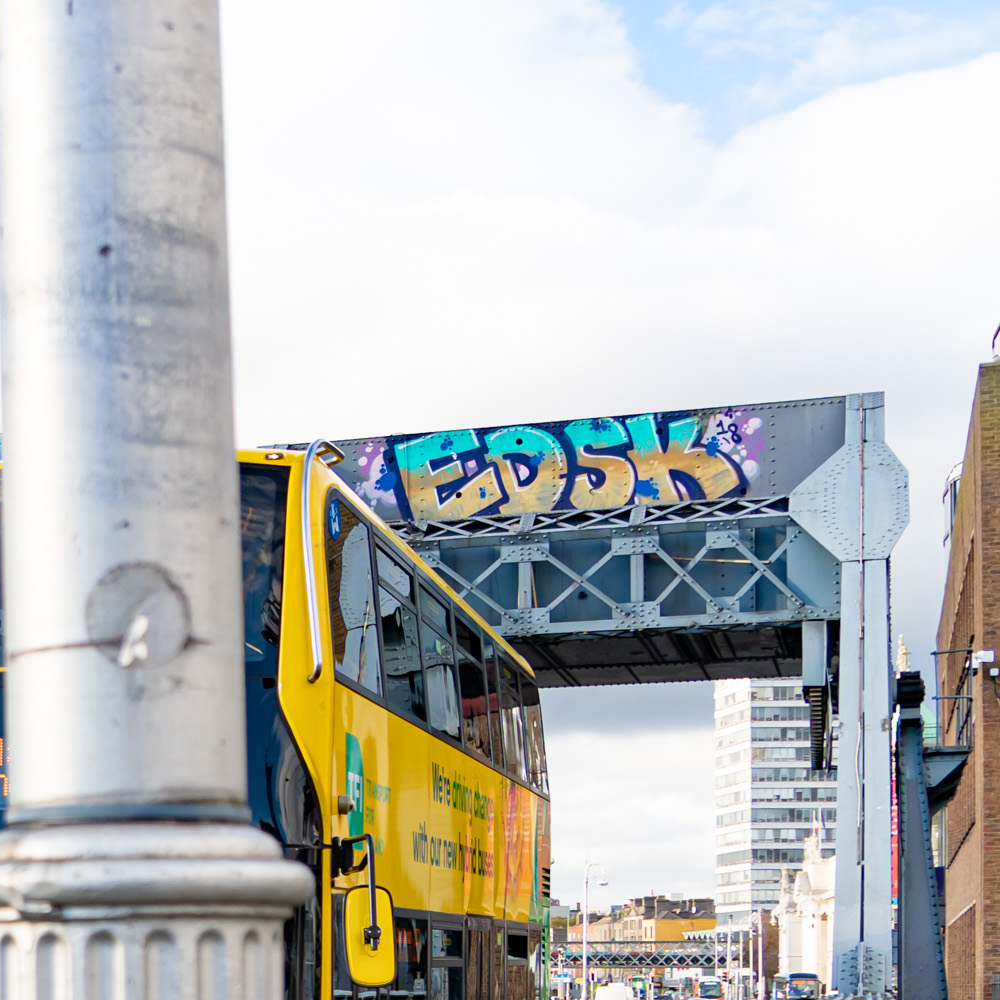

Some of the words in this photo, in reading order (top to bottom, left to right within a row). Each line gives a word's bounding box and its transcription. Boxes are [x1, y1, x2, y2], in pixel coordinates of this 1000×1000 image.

[392, 412, 746, 522] EDSK
[347, 771, 363, 813] TFI
[452, 769, 472, 827] driving
[412, 821, 429, 865] with
[430, 836, 442, 867] our
[443, 839, 458, 870] new
